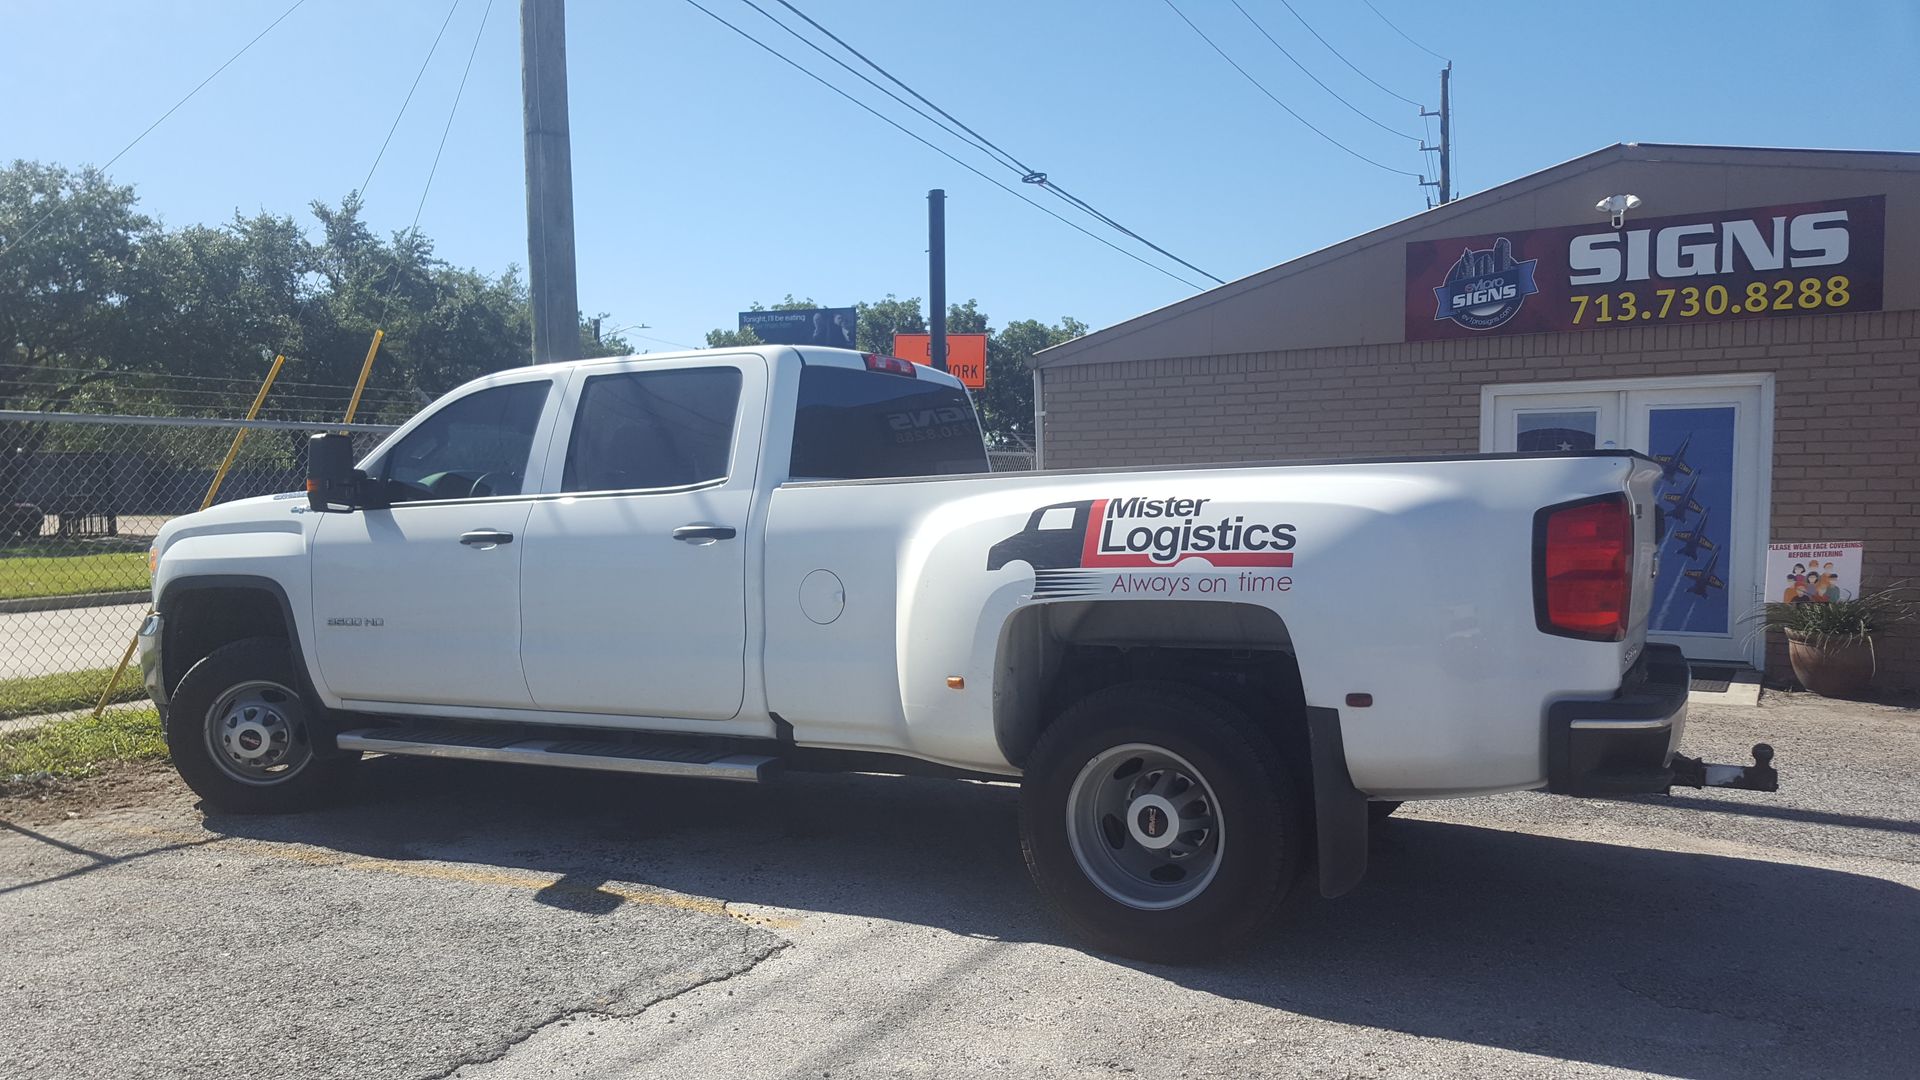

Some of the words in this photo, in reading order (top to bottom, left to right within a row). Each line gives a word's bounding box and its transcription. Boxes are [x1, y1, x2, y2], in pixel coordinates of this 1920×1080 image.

[1569, 210, 1850, 286] SIGNS
[1452, 283, 1517, 309] SIGNS
[1570, 275, 1851, 326] 713.730.8288
[1106, 496, 1211, 518] Mister
[1101, 516, 1297, 561] Logistics
[1768, 543, 1791, 551] PLEASE
[1788, 551, 1811, 559] BEFORE
[1813, 550, 1843, 558] ENTERING
[1111, 572, 1192, 596] Always
[1198, 577, 1227, 593] on
[1238, 571, 1293, 592] time
